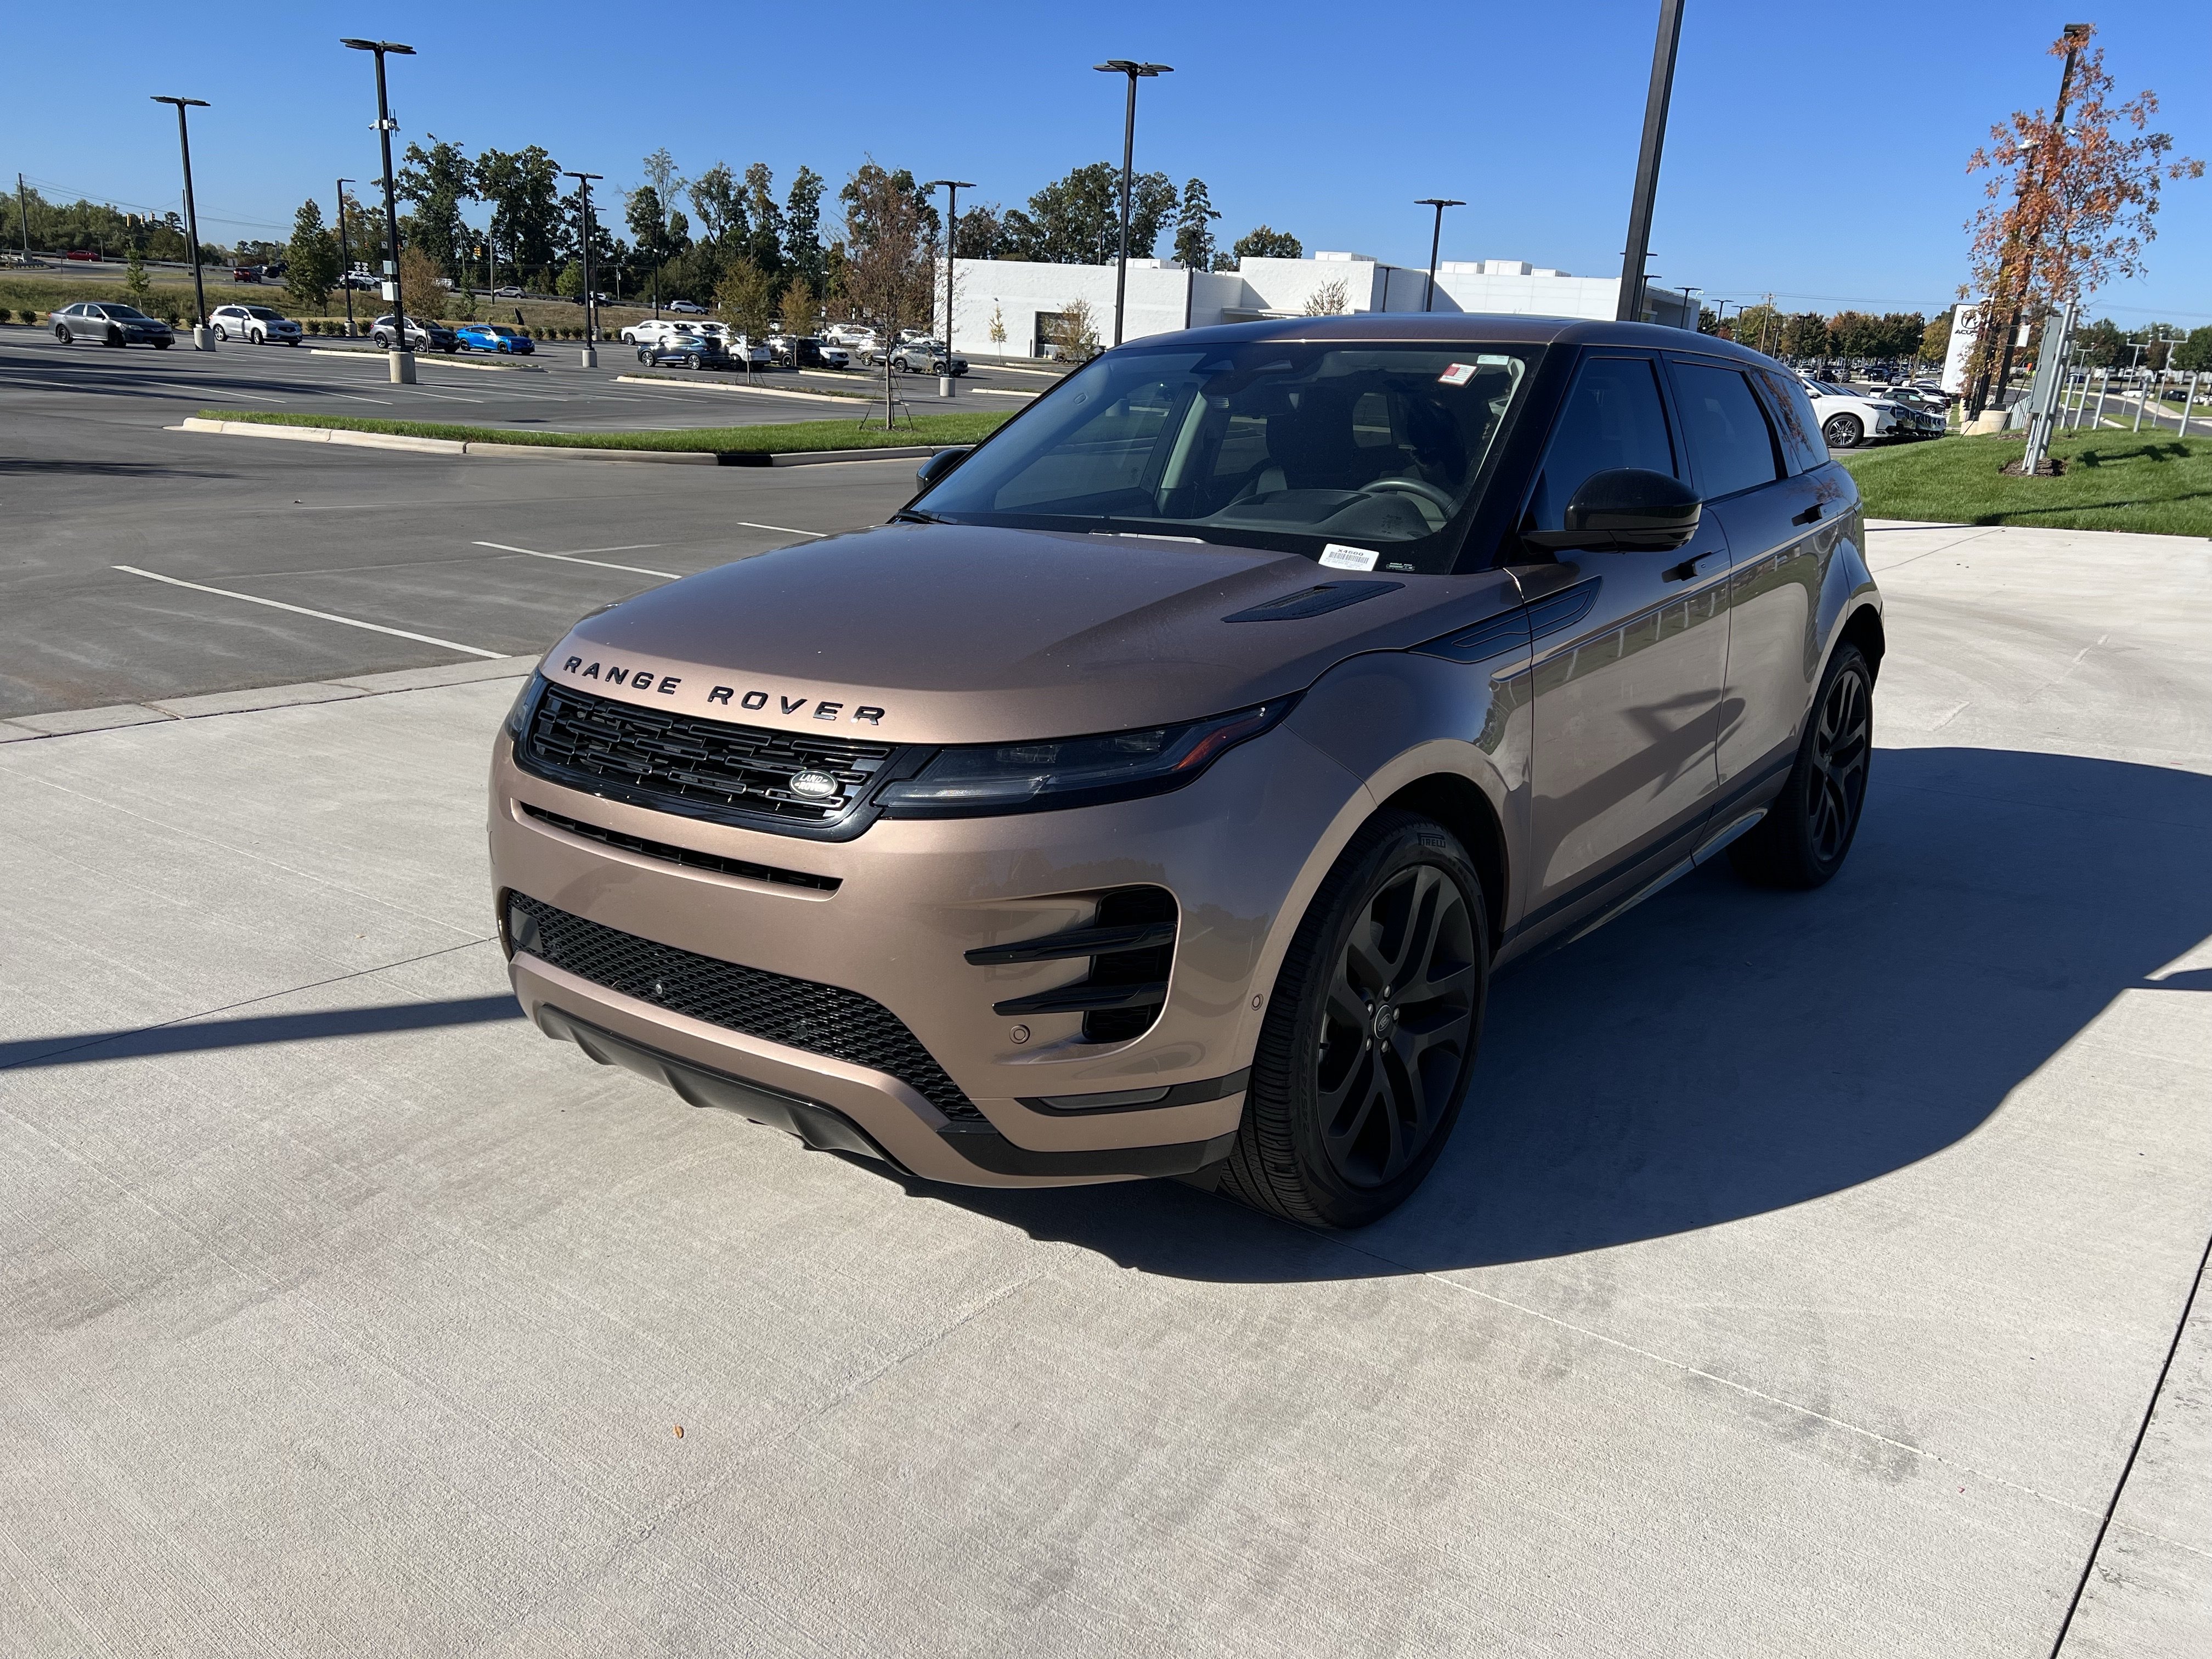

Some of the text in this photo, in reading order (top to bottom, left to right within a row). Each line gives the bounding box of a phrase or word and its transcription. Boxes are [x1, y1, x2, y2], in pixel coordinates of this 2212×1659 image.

[563, 655, 885, 726] RANGE ROVER
[798, 774, 823, 783] LAND
[1417, 832, 1446, 848] PIRELLI
[1301, 1062, 1310, 1133] 245/45
